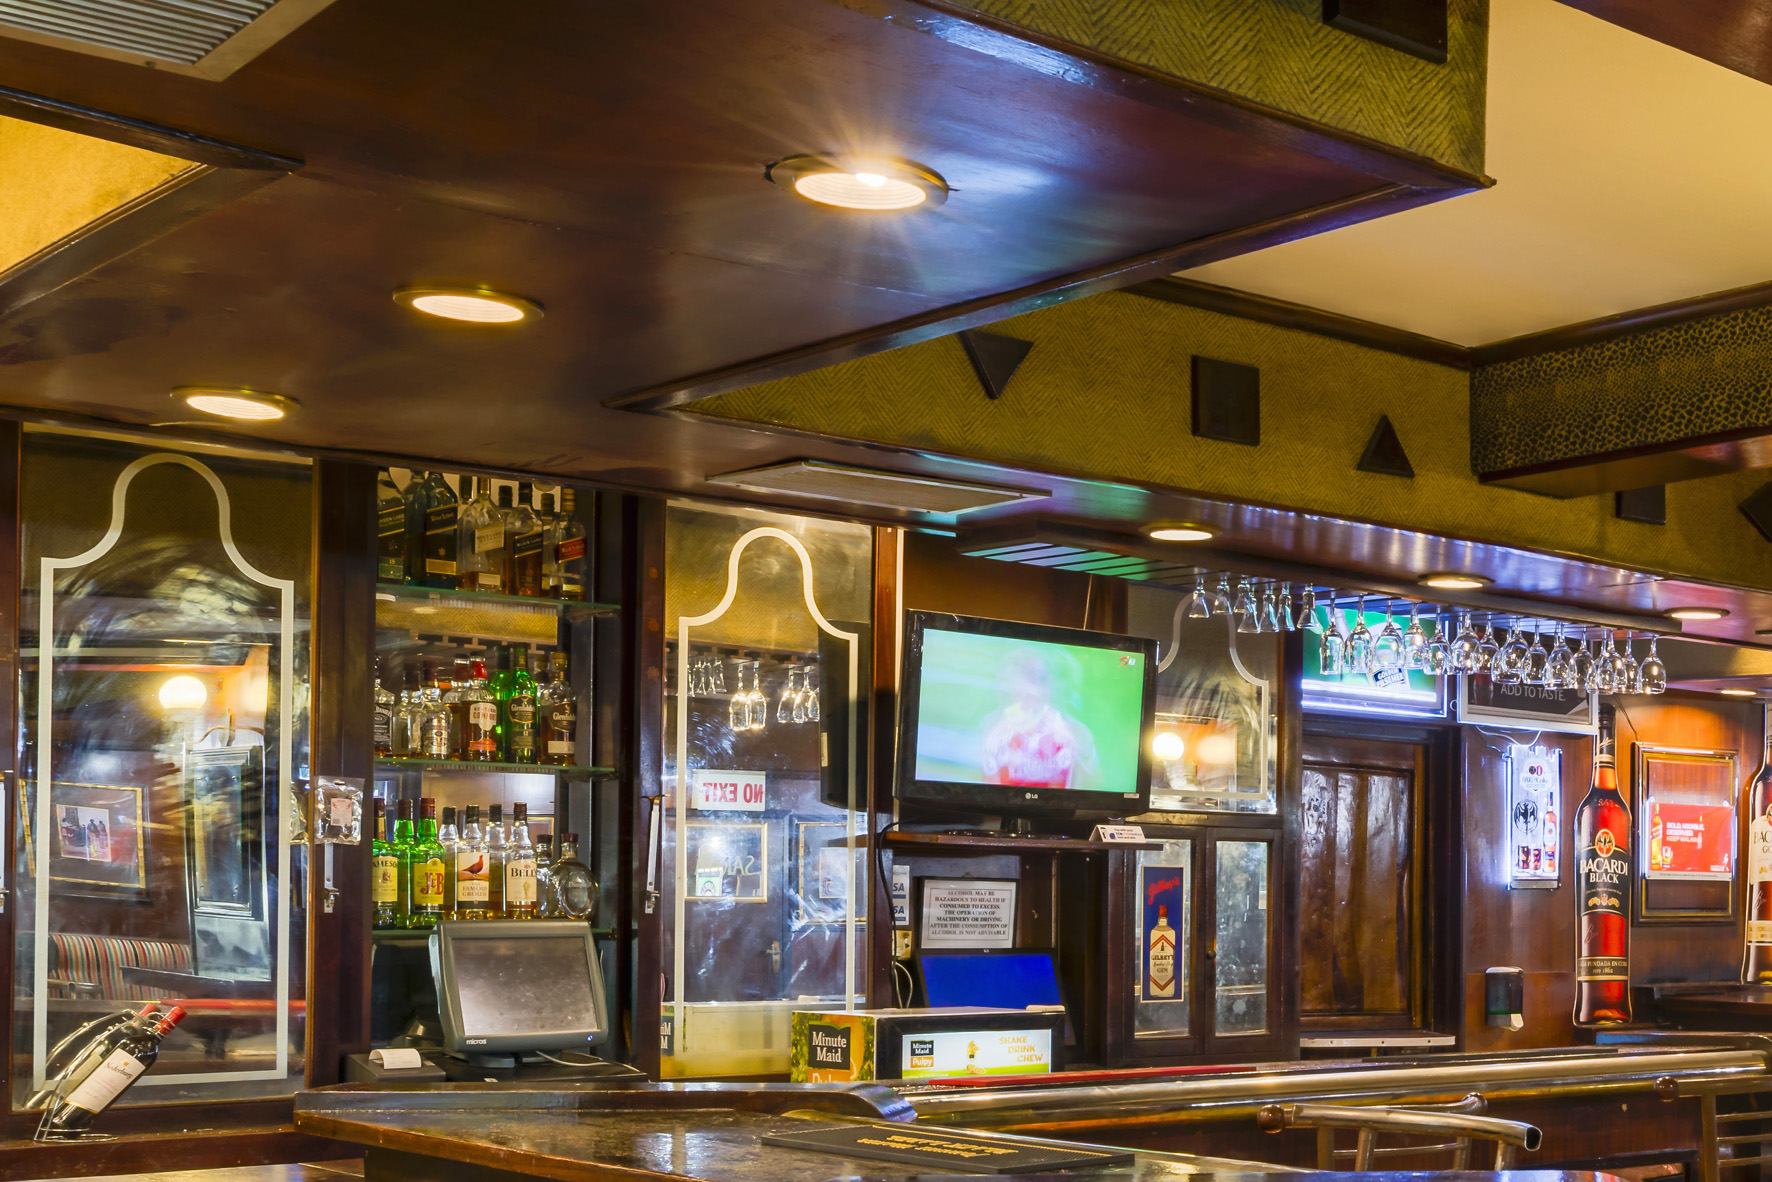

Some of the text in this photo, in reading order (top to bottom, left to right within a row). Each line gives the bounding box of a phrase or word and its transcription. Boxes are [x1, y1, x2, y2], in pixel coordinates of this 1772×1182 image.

[1377, 667, 1399, 681] GOLDEN
[1501, 684, 1566, 701] ADD TO TASTE.
[1579, 857, 1628, 876] BACARDI
[1589, 872, 1620, 884] BLACK
[893, 882, 904, 892] SA
[893, 905, 904, 914] SA
[812, 1031, 847, 1048] Minute
[999, 1035, 1027, 1044] SHAKE
[816, 1046, 842, 1062] Maid
[1007, 1044, 1036, 1054] DRINK
[912, 1057, 933, 1067] Pulpy
[1016, 1053, 1043, 1063] CHEW
